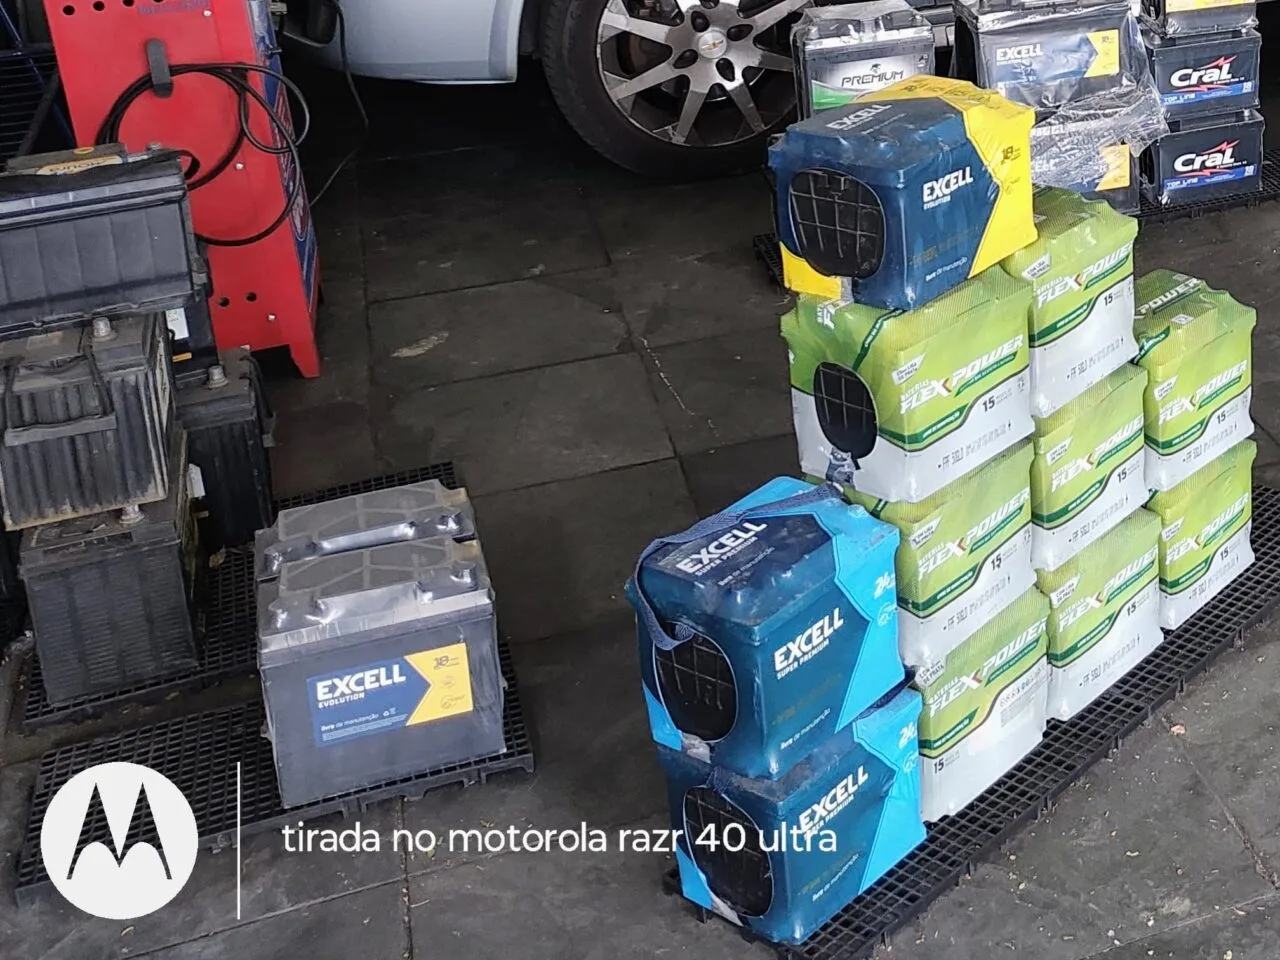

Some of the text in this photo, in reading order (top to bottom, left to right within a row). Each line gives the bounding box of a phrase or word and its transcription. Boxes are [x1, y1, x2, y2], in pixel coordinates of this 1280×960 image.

[996, 44, 1045, 61] EXCELL
[841, 70, 905, 87] PREMIUM
[826, 103, 892, 130] EXCELL
[922, 166, 974, 203] EXCELL
[1104, 292, 1114, 307] 15
[1139, 277, 1202, 315] POWER
[951, 334, 1024, 386] POWER
[982, 396, 996, 413] 15
[1217, 410, 1226, 424] 15
[1094, 414, 1144, 458] POWE
[1117, 468, 1128, 483] 15
[676, 521, 768, 574] EXCELL
[695, 536, 759, 577] SUPER PREMIUM
[1220, 546, 1229, 561] 15
[991, 553, 1002, 571] 15
[1127, 601, 1136, 616] 15
[773, 607, 844, 673] EXCELL
[776, 638, 830, 680] SUPER PREMIUM
[316, 664, 406, 701] EXCELL
[318, 692, 365, 709] EVOLUTION
[321, 713, 379, 732] livre de manutenção
[934, 758, 944, 774] 15
[799, 765, 869, 832] EXCELL
[825, 794, 855, 823] PREMIUM
